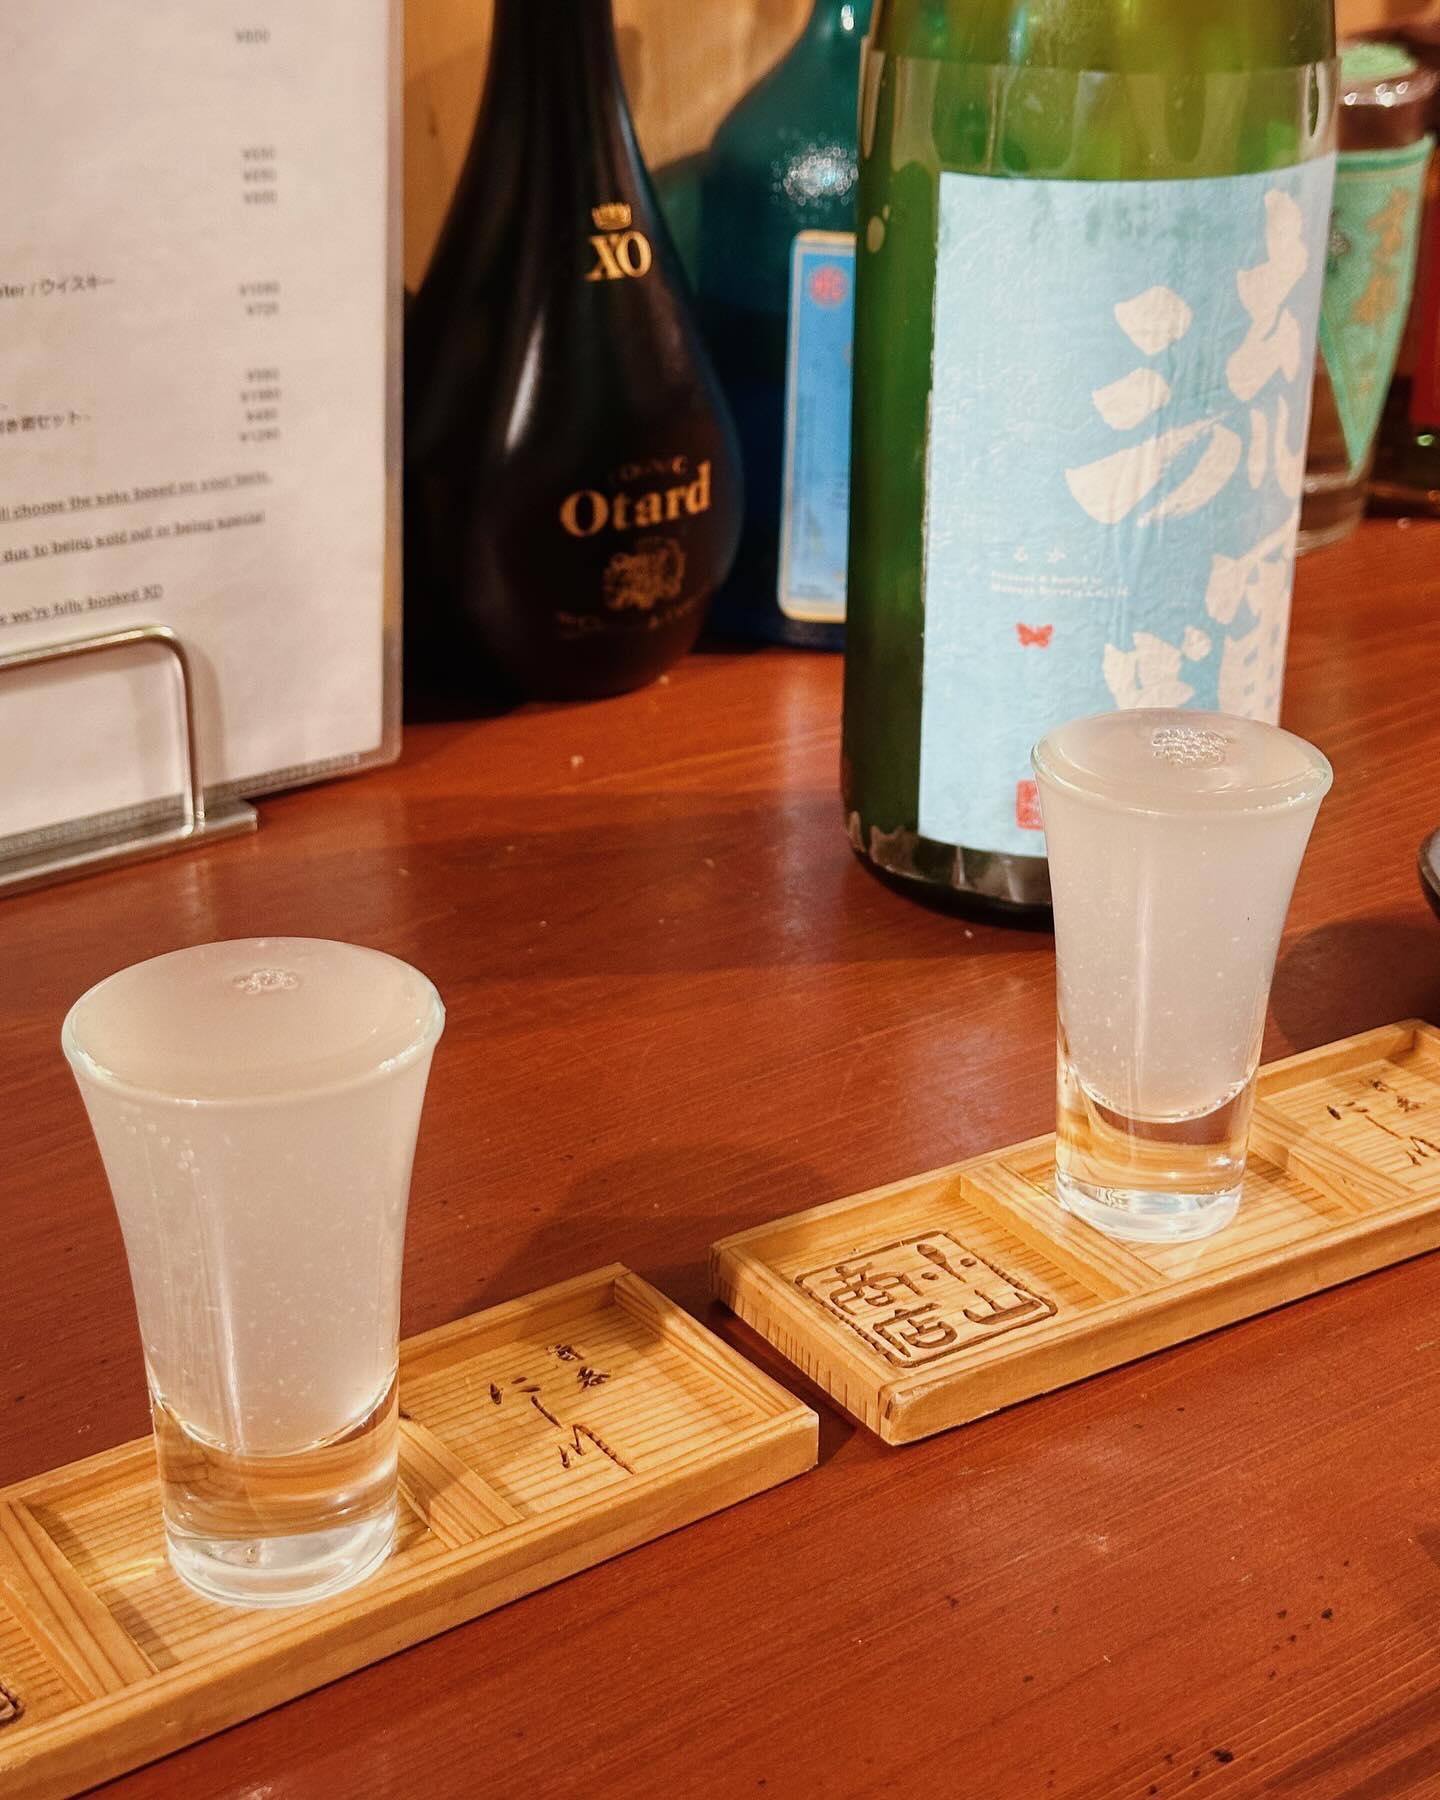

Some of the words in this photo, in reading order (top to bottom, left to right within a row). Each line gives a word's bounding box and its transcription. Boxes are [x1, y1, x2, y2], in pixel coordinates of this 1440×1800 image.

[585, 231, 653, 281] XO
[14, 501, 64, 520] choose
[70, 495, 91, 511] the
[560, 460, 712, 537] Otard
